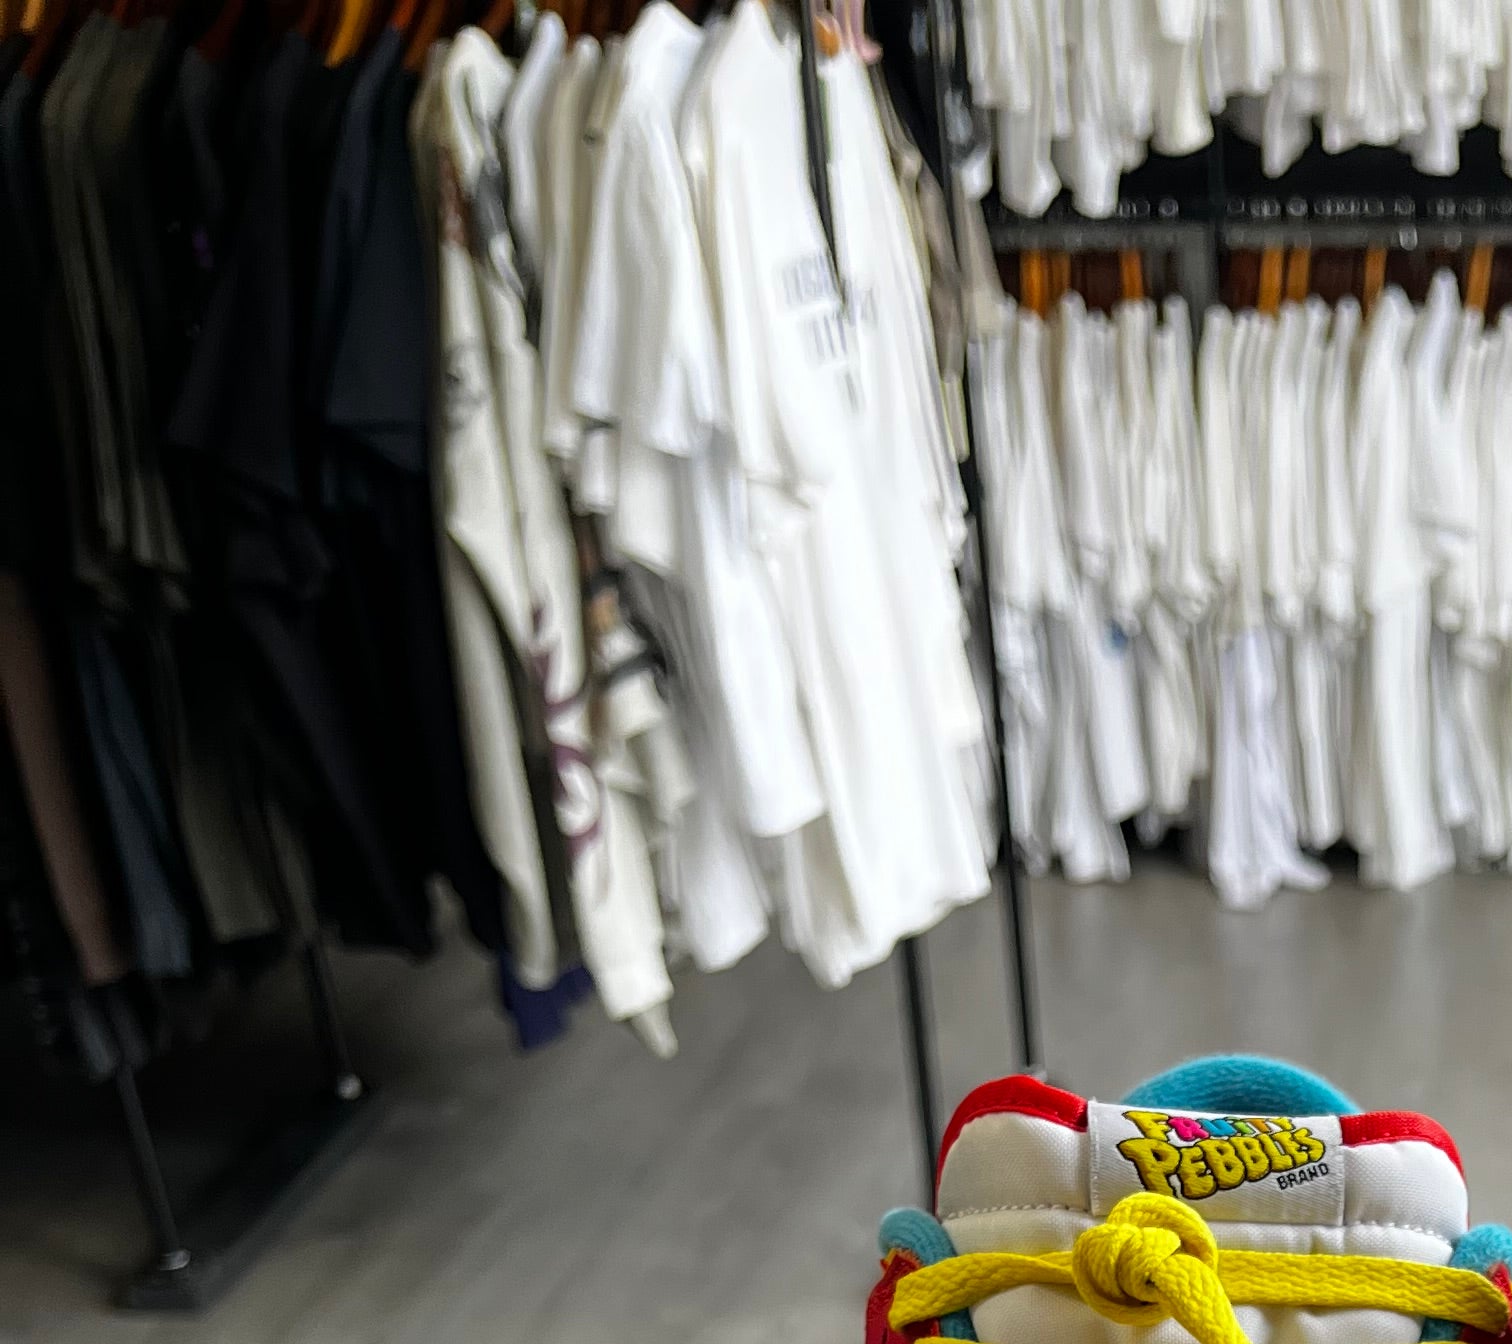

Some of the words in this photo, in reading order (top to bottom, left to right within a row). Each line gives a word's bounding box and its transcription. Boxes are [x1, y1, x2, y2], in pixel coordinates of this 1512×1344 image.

[1122, 1110, 1296, 1142] FRUITY
[1117, 1127, 1326, 1200] PEBBLES
[1275, 1162, 1330, 1191] BRAND
